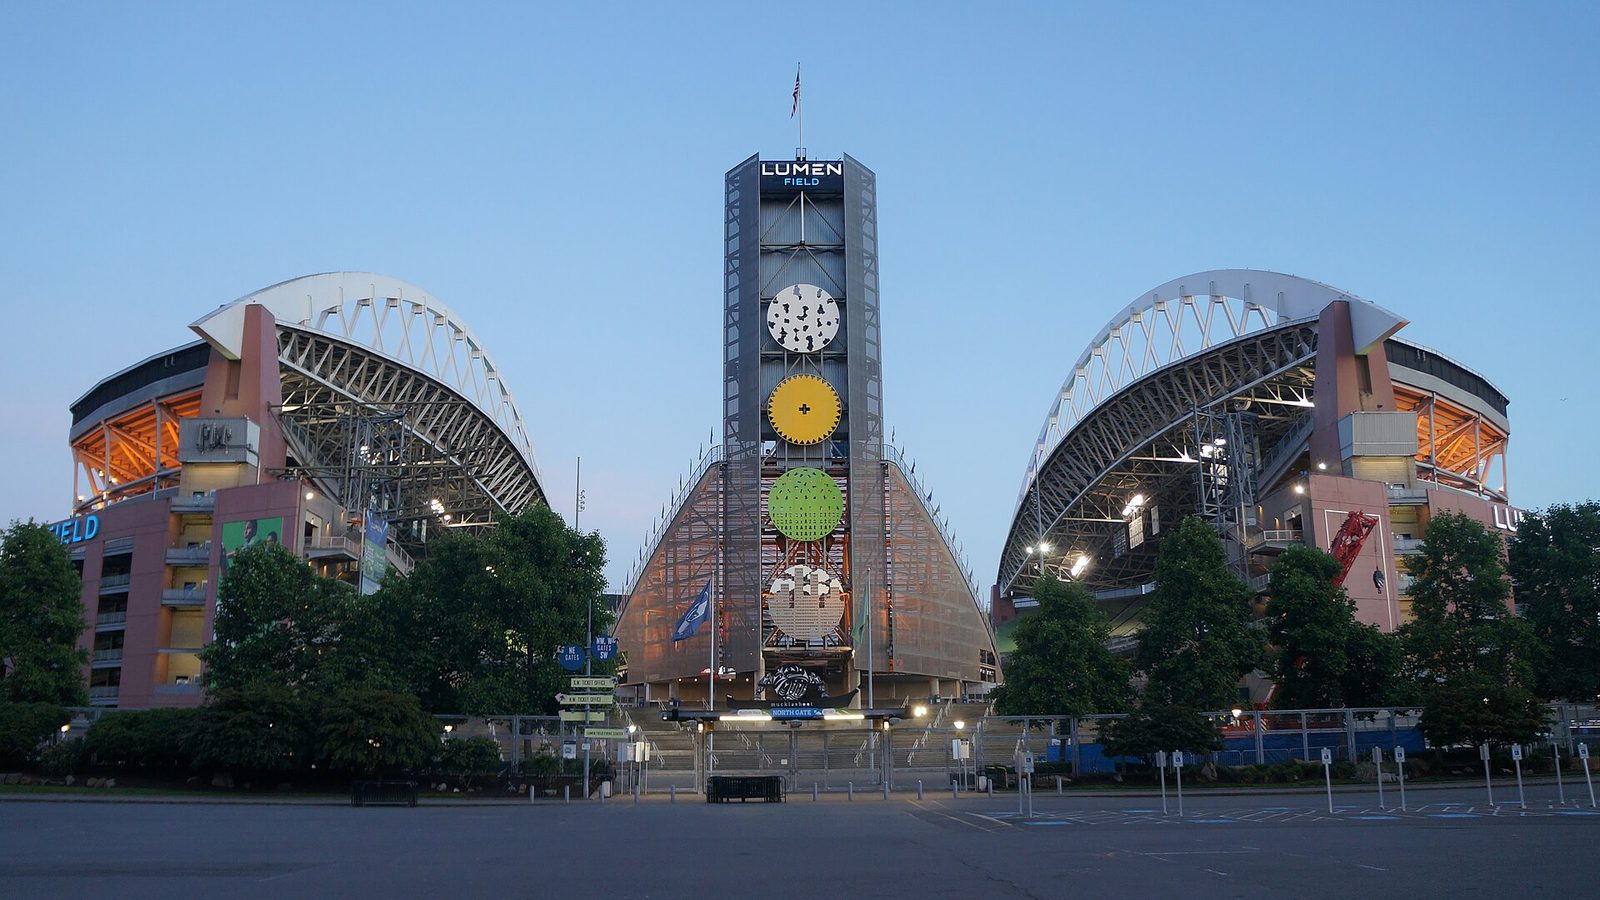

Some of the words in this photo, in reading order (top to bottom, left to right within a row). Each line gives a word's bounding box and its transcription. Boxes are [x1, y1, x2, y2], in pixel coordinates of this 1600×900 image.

[761, 163, 842, 176] LUMEN
[784, 177, 820, 186] FIELD
[569, 646, 576, 654] NE
